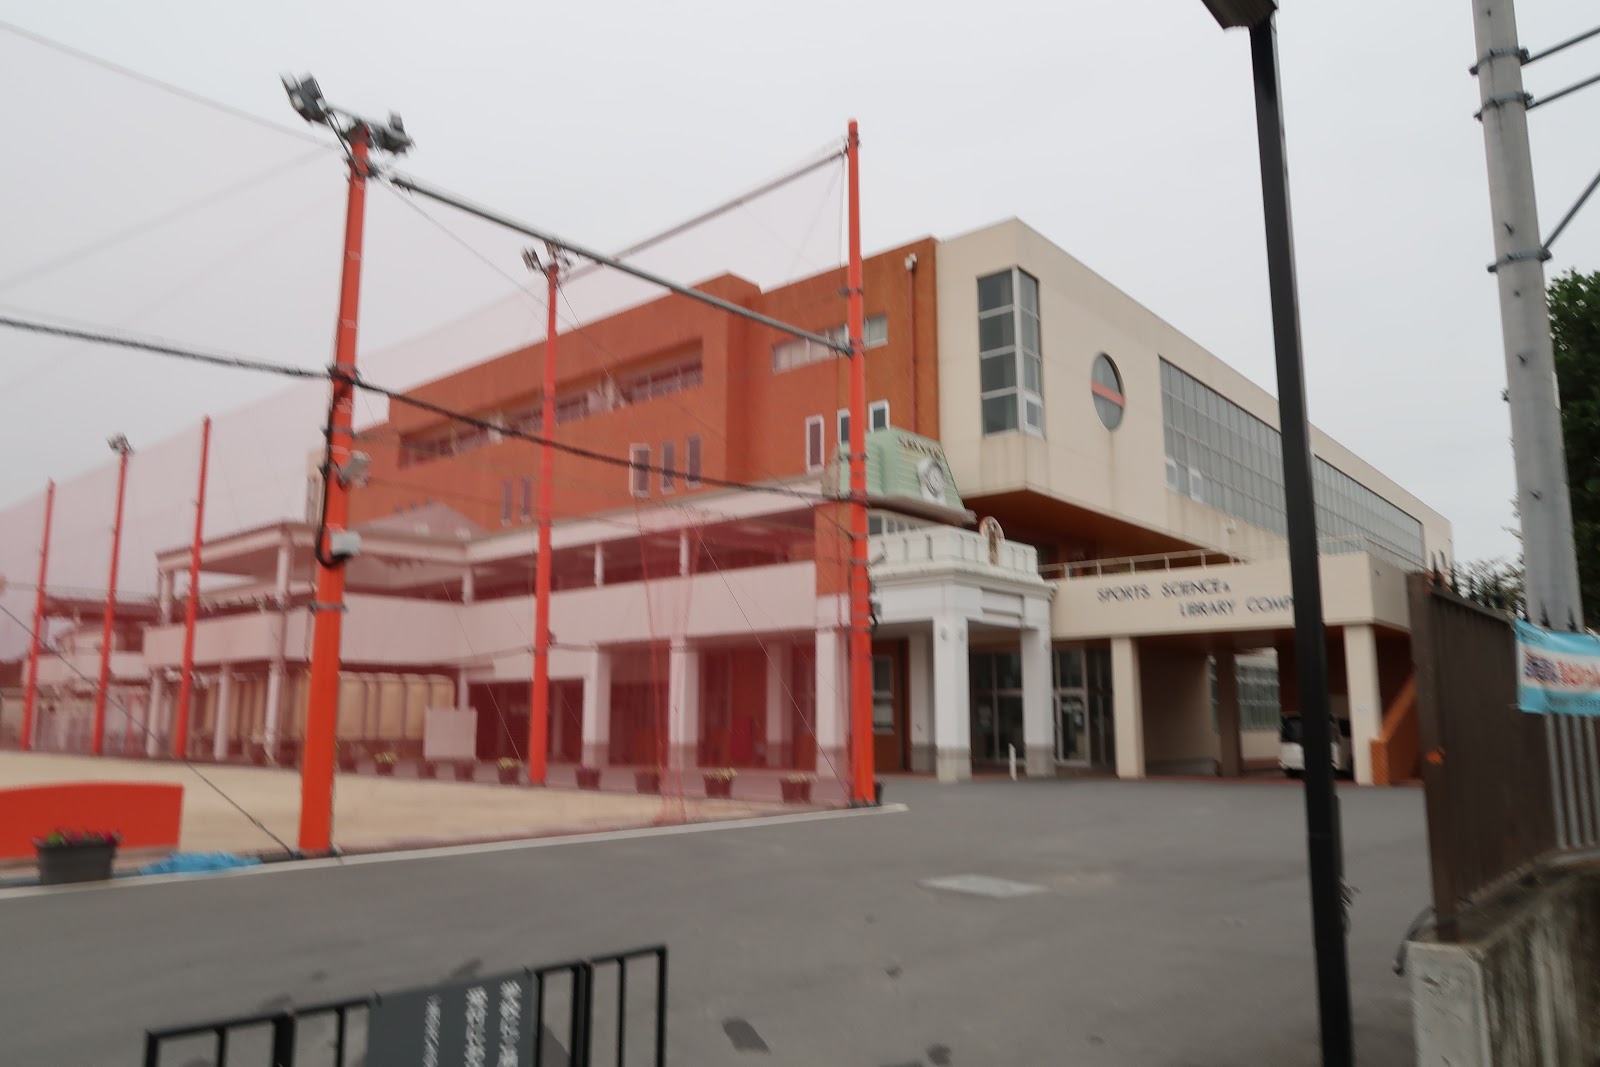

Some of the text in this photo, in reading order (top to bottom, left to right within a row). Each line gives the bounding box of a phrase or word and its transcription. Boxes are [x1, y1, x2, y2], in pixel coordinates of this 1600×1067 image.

[1097, 584, 1151, 603] SPORTS
[1180, 595, 1294, 617] LIBRARY COMP
